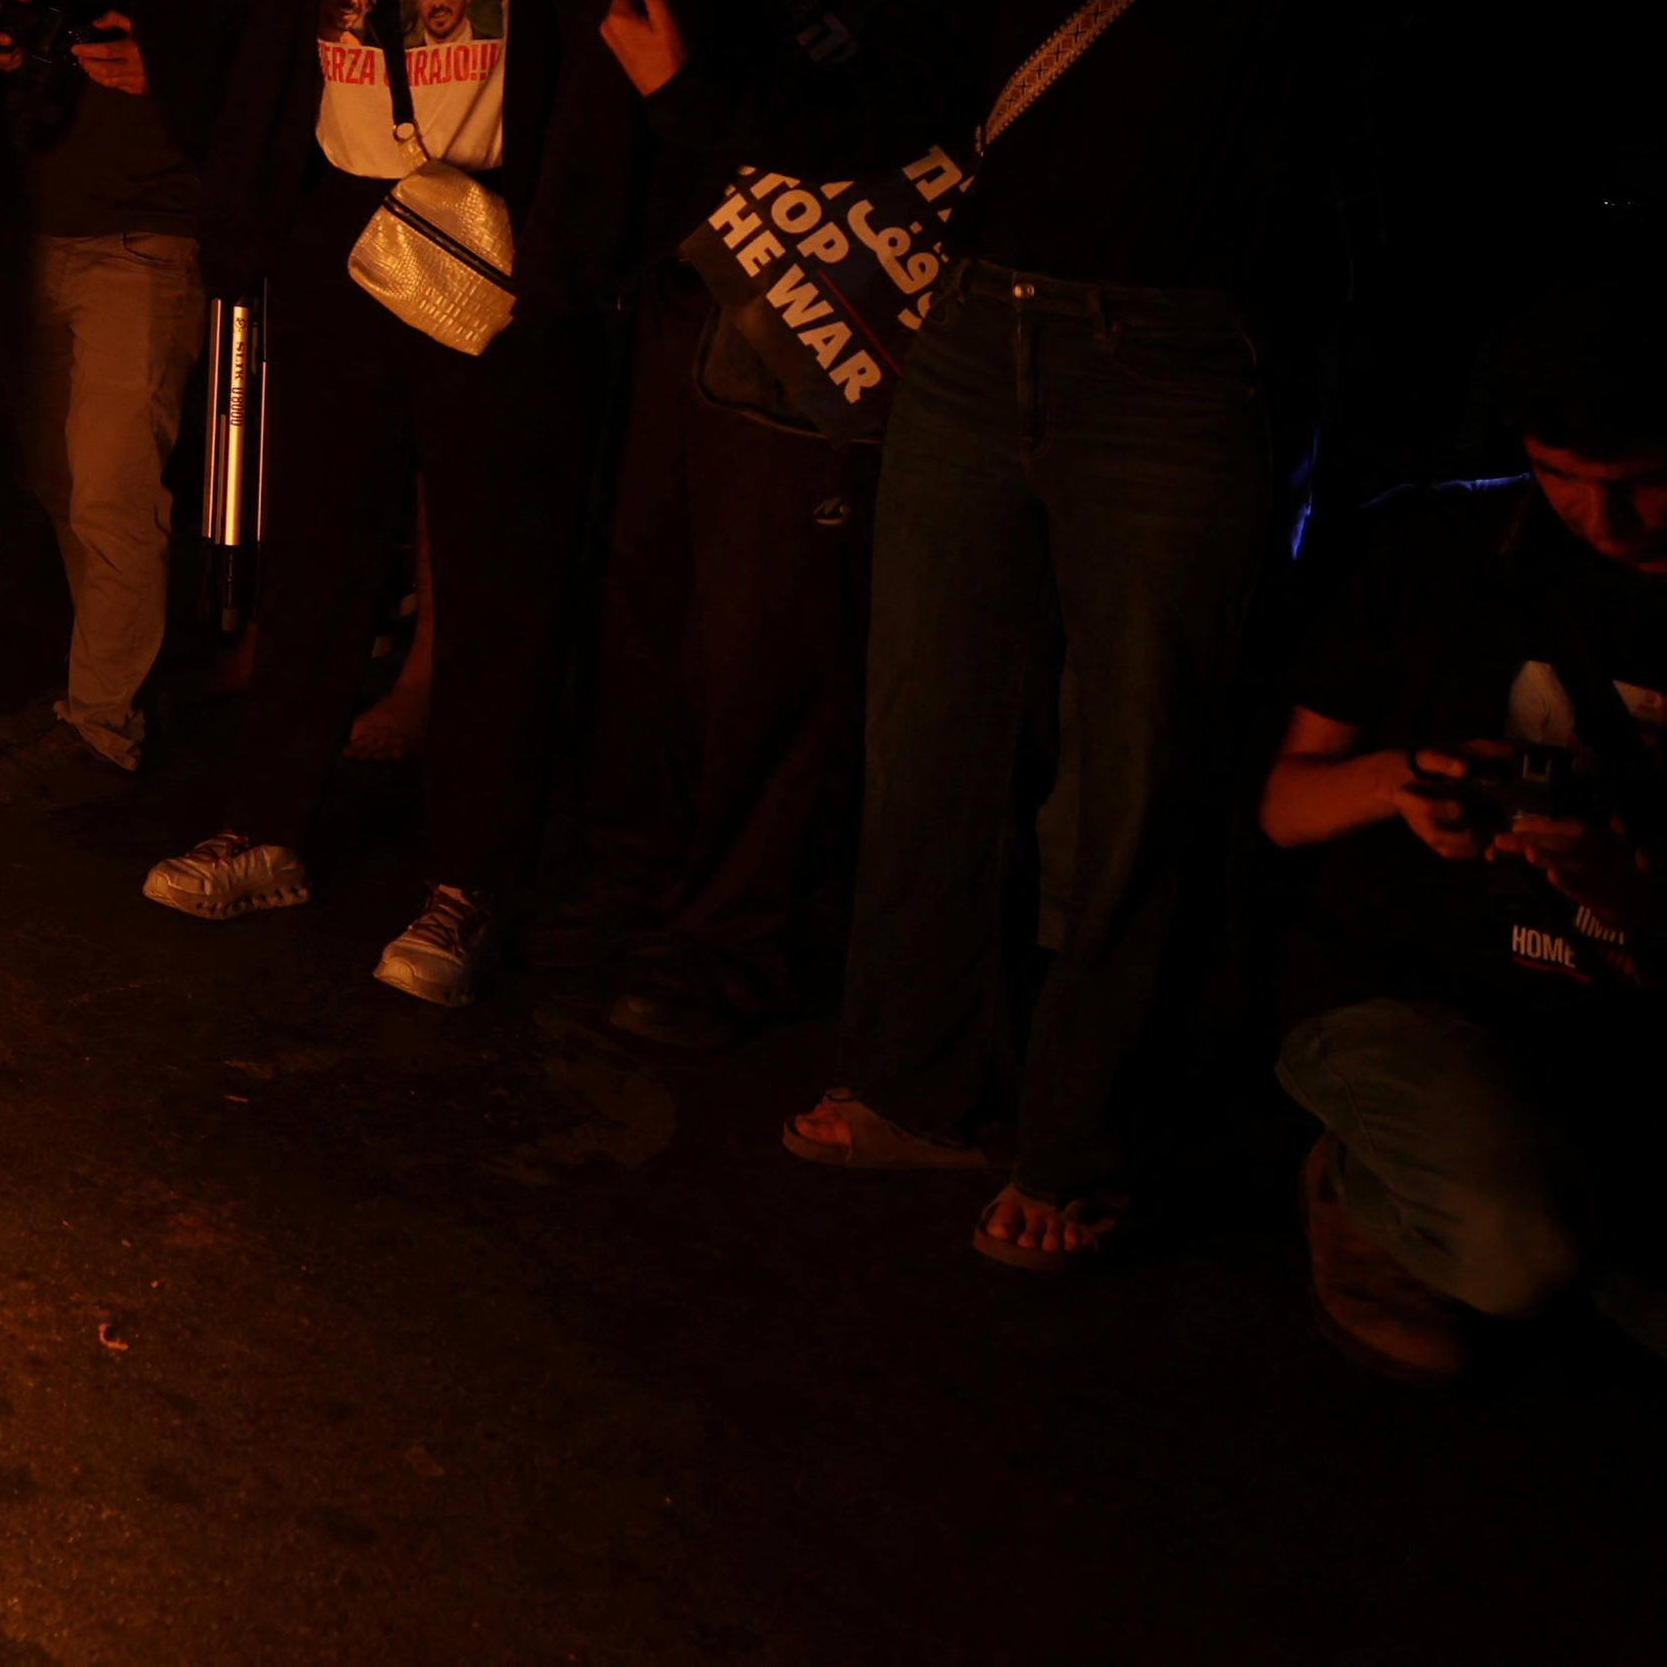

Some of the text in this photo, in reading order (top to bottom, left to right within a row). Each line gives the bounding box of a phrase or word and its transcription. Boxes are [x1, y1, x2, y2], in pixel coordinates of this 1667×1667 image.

[319, 45, 375, 85] ERZA
[736, 163, 850, 264] TOP
[707, 184, 882, 404] HE WAR
[1512, 924, 1577, 969] HOME
